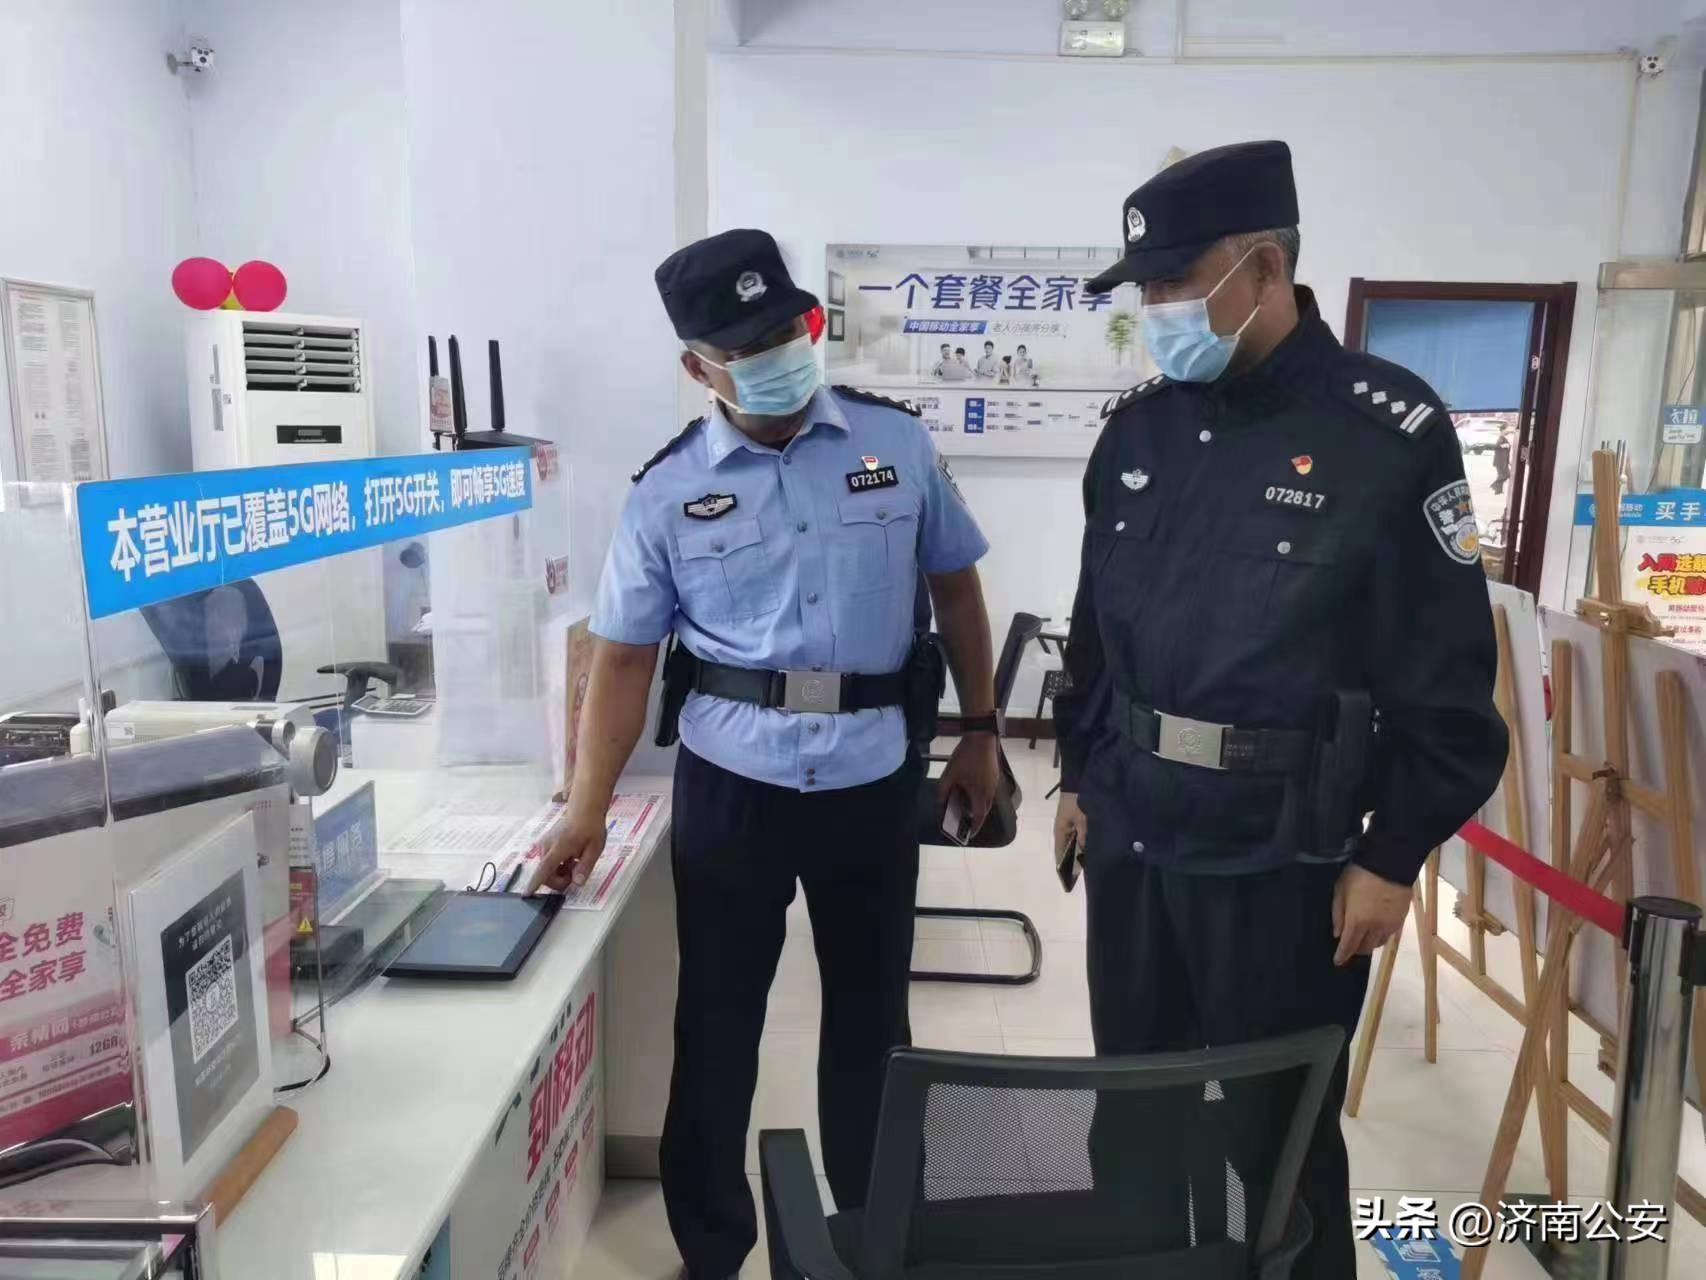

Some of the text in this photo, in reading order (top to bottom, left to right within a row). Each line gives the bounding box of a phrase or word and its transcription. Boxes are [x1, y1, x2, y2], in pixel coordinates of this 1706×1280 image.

[858, 273, 1112, 312] 一个套餐全家享
[851, 470, 894, 488] 072174
[1265, 486, 1325, 509] 072817
[1655, 501, 1706, 521] 买手
